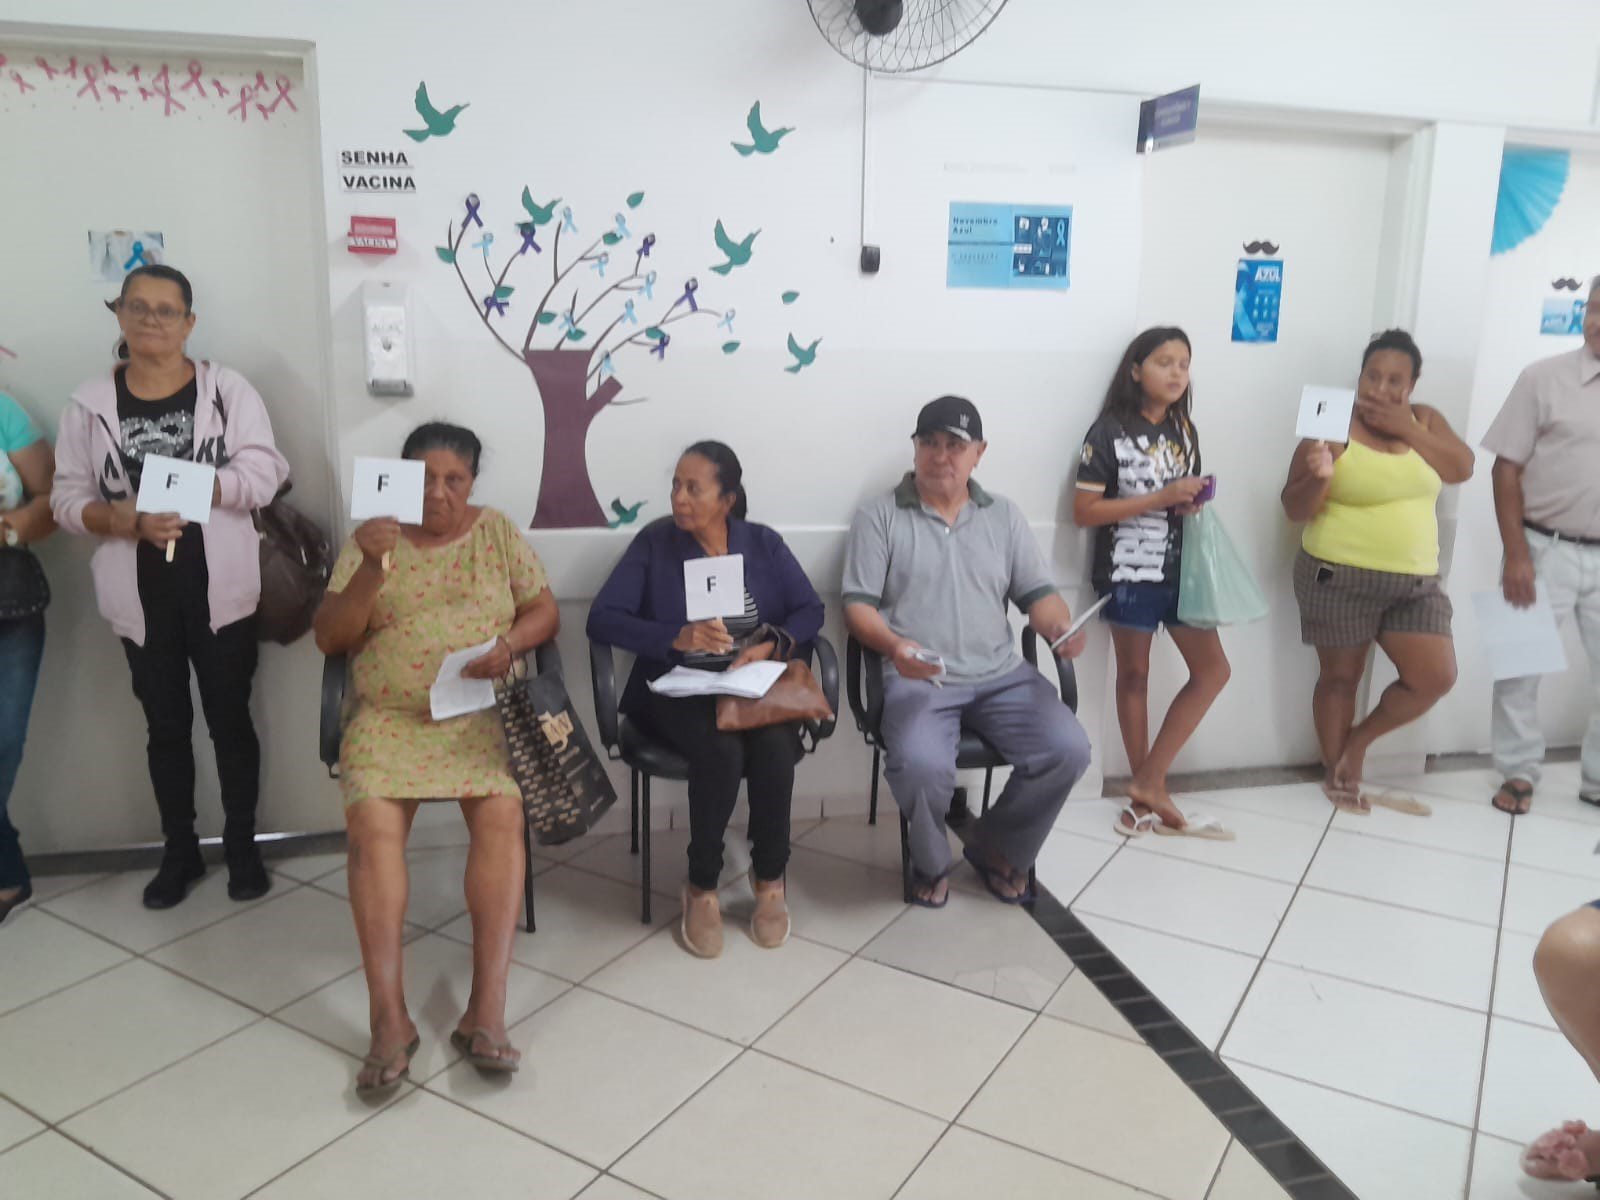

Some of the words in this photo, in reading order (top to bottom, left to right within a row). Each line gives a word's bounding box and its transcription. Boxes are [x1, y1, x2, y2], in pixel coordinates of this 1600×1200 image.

[341, 150, 408, 165] SENHA
[342, 175, 416, 190] VACINA
[1316, 400, 1327, 416] F
[166, 472, 180, 489] F
[377, 473, 390, 491] F
[705, 575, 716, 592] F
